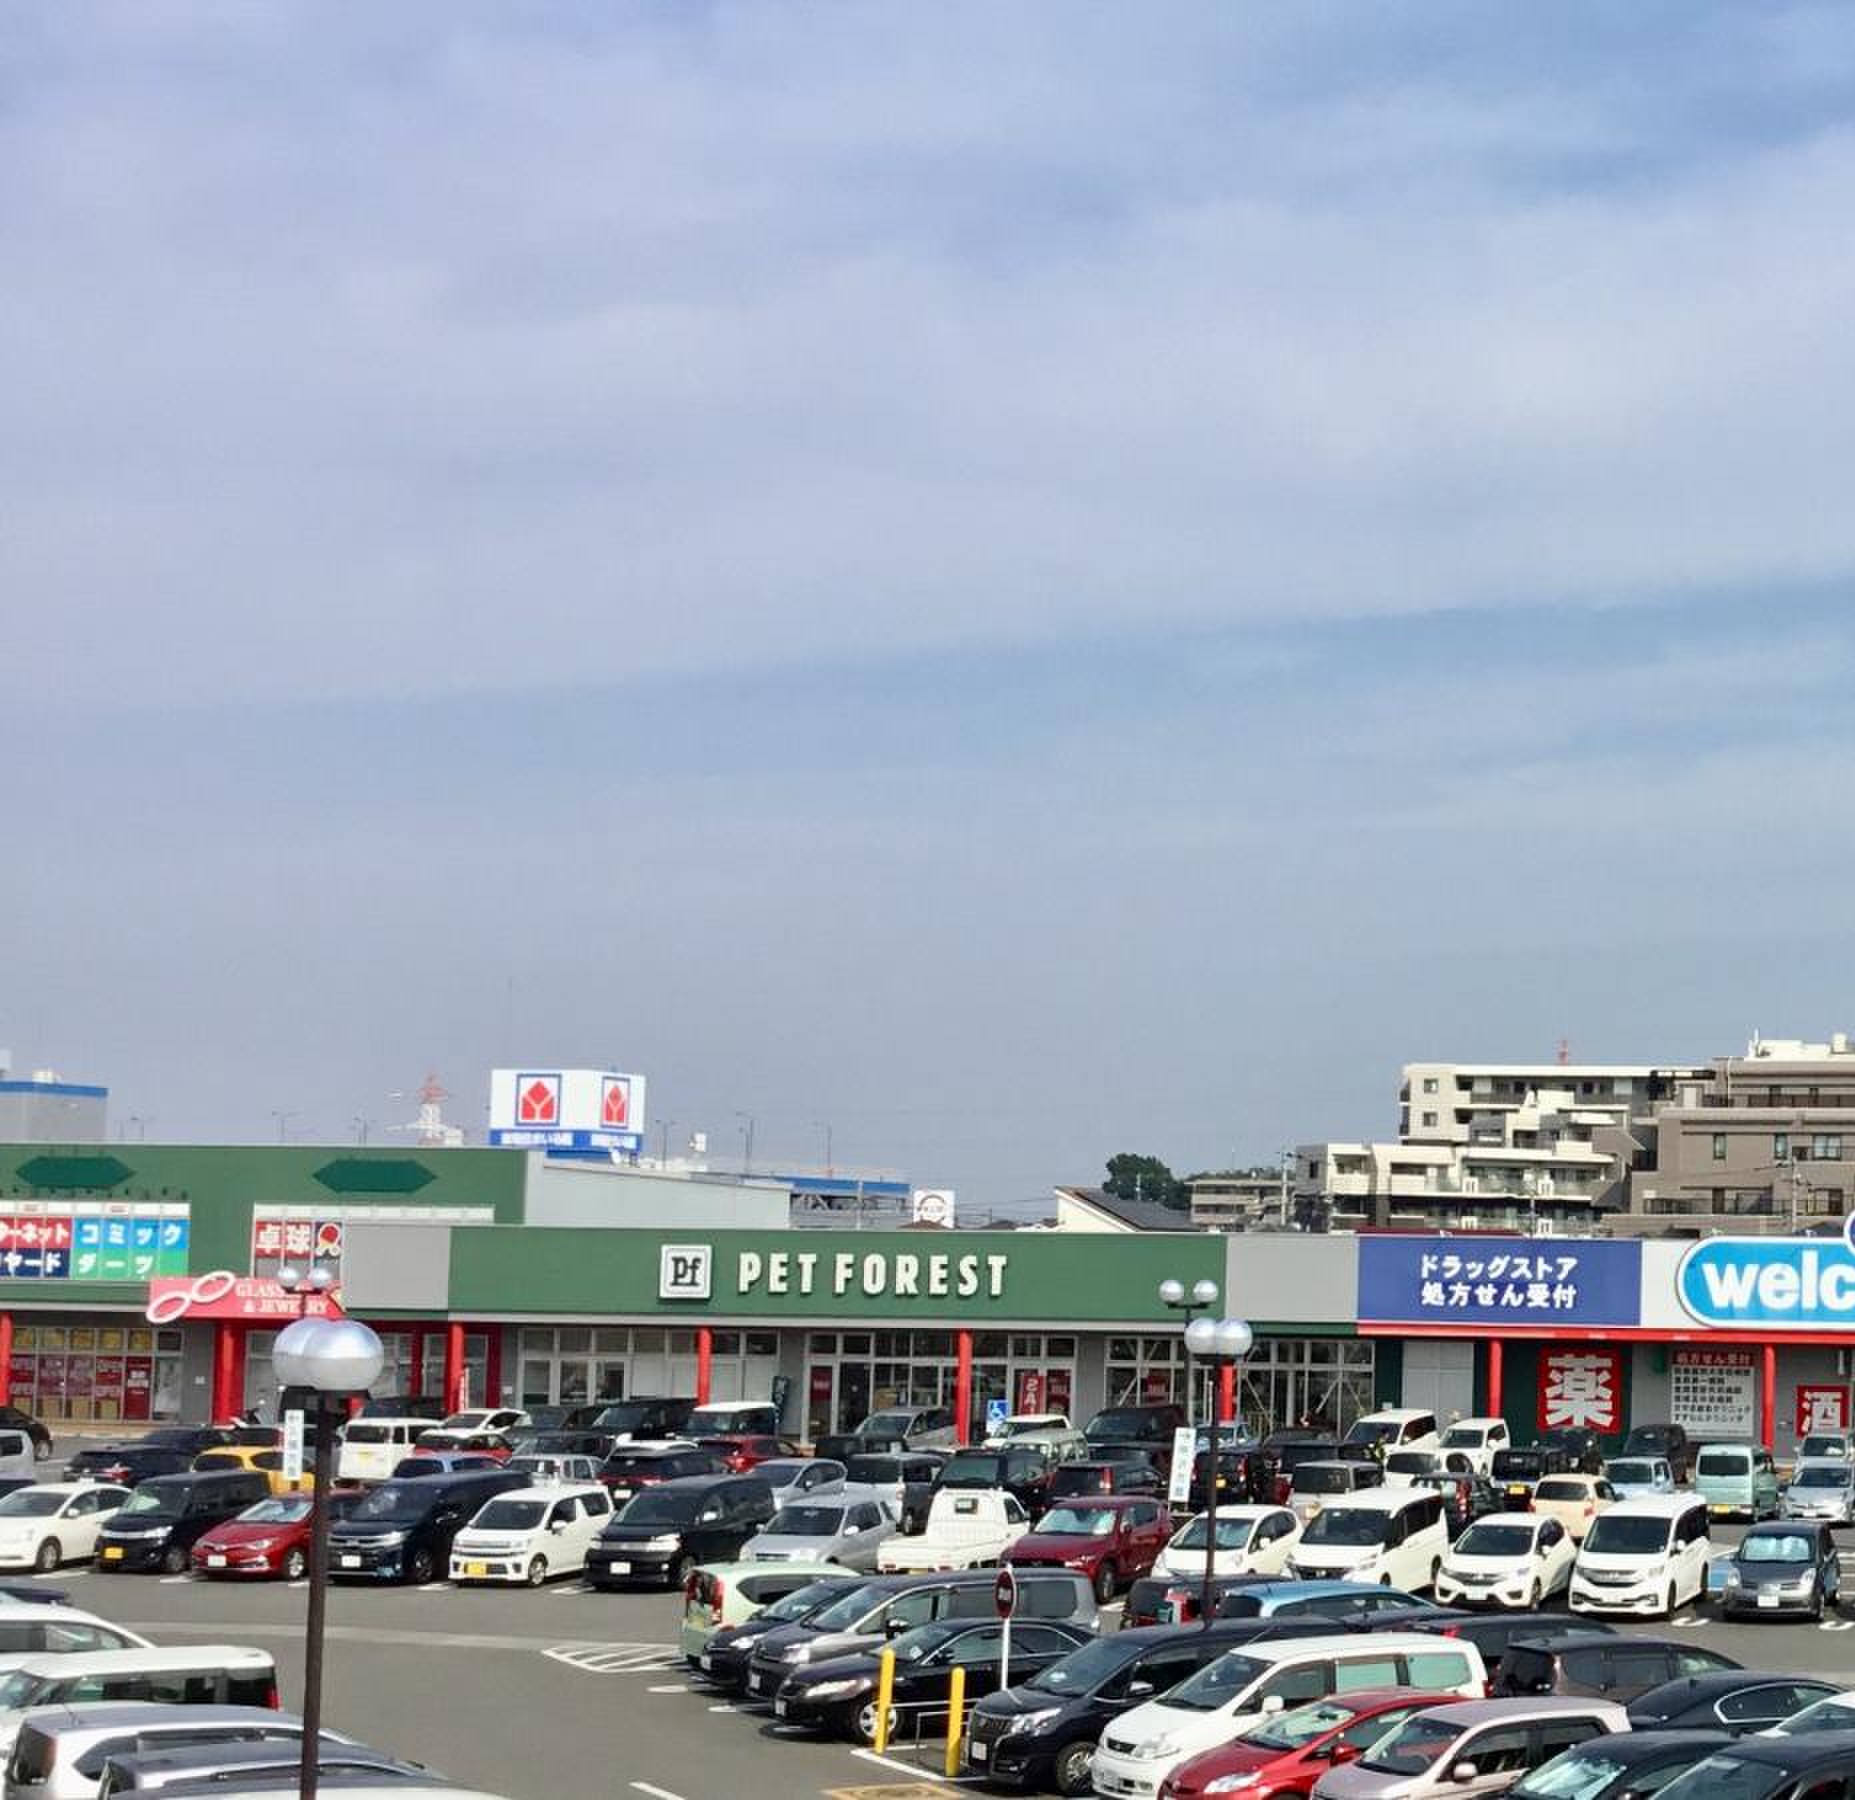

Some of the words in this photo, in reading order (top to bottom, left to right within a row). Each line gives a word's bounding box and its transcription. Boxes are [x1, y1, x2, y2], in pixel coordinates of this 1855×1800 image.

[82, 1223, 182, 1245] コミック
[738, 1253, 817, 1293] PET
[833, 1254, 1008, 1296] FOREST
[1421, 1254, 1578, 1280] ドラッグストア
[1421, 1282, 1577, 1309] 処方せん受付
[1545, 1354, 1615, 1427] 薬
[1802, 1391, 1843, 1432] 酒
